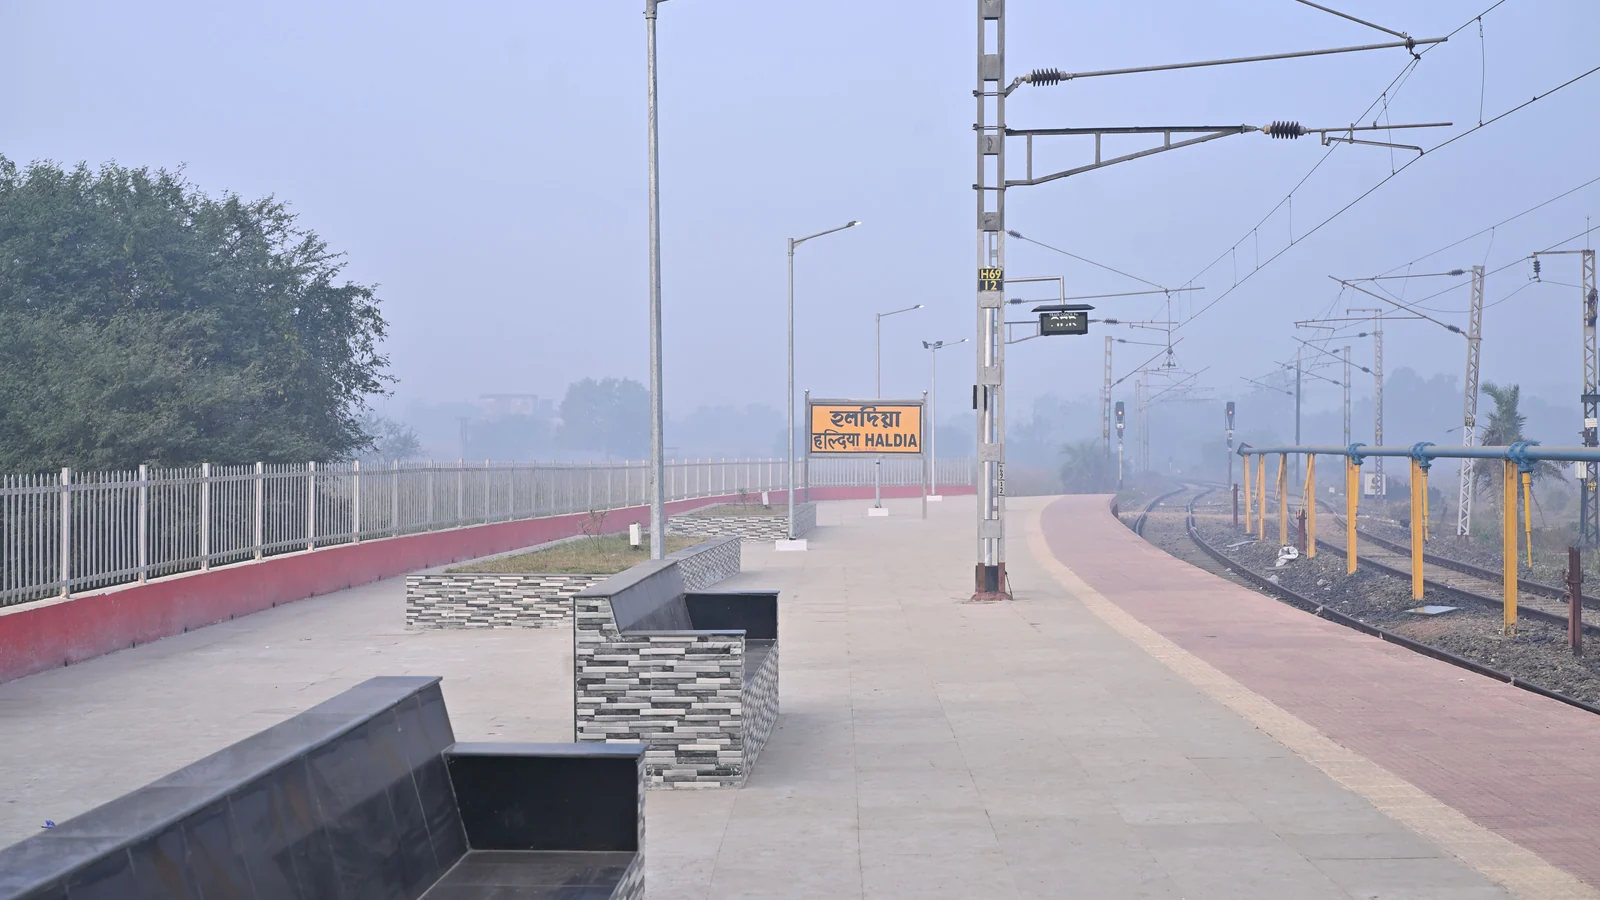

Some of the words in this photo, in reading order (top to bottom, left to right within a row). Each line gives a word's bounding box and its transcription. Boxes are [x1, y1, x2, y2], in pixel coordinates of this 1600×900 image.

[981, 269, 1001, 279] H69
[985, 281, 997, 291] 12
[829, 406, 901, 428] হলদিয়া
[812, 429, 860, 449] हल्दिया
[865, 434, 917, 447] HALDIA
